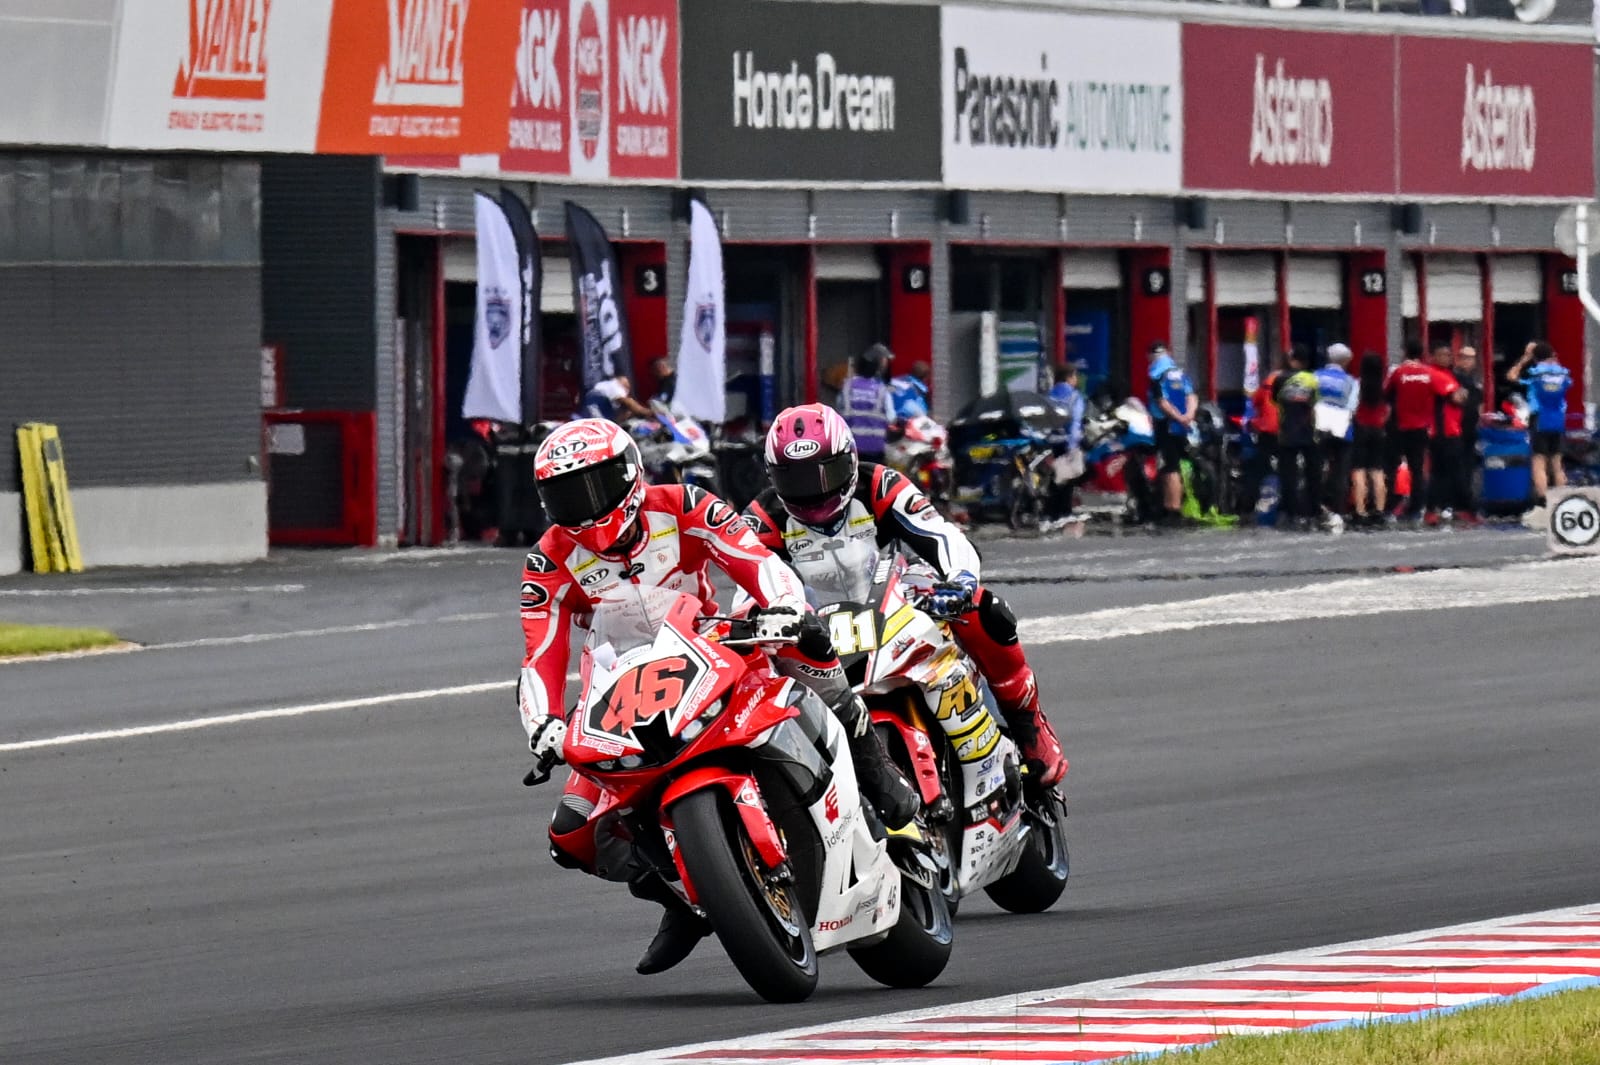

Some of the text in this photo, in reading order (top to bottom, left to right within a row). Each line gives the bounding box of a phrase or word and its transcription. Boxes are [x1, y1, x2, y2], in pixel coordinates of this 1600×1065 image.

[617, 15, 669, 117] NGK
[733, 51, 895, 130] Honda Dream
[954, 47, 1058, 149] Panasonic
[1250, 53, 1332, 167] Astemo
[1461, 63, 1536, 172] Astemo
[643, 269, 658, 292] 3
[786, 441, 816, 457] Arai
[1560, 510, 1594, 531] 60
[828, 609, 877, 656] 41
[600, 656, 687, 736] 46
